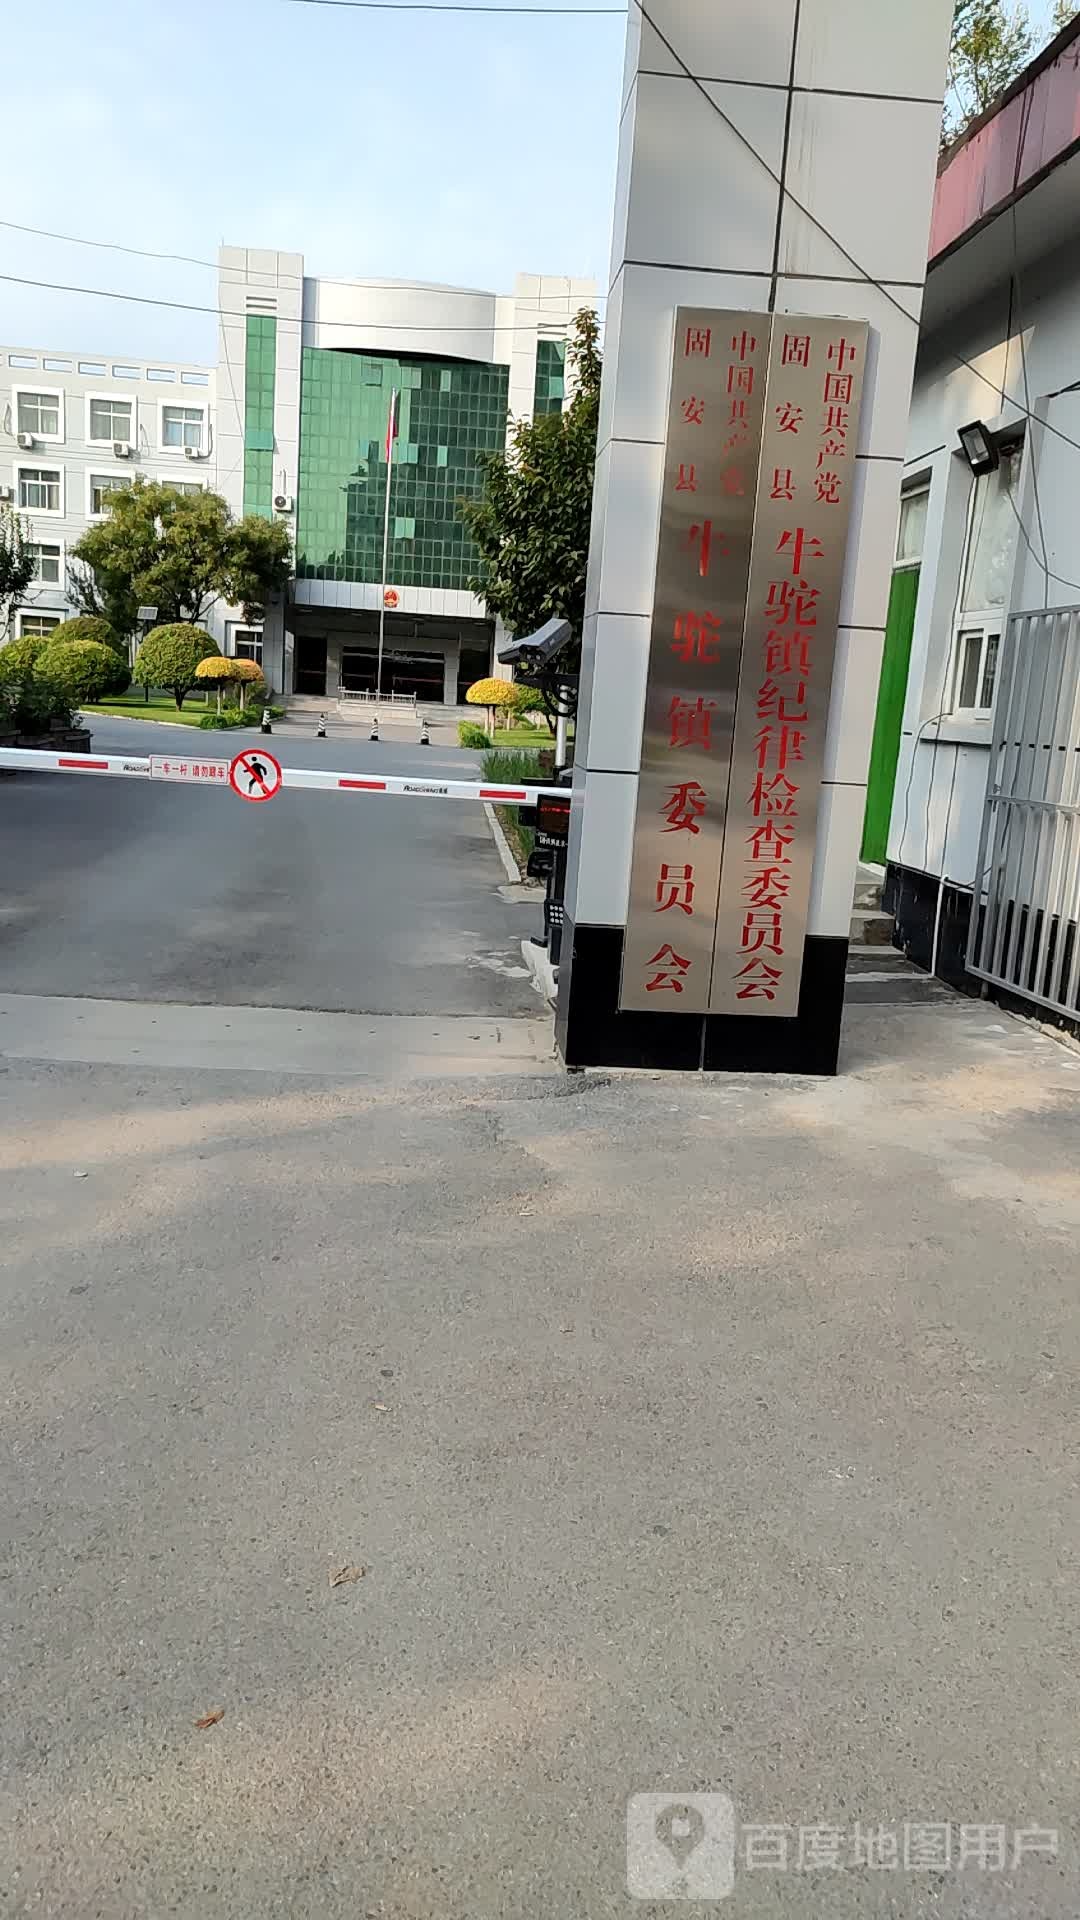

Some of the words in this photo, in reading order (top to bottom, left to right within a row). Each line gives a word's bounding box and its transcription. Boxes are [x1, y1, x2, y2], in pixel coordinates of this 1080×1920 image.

[675, 327, 712, 492] 固安县
[769, 333, 812, 501] 固安县
[814, 338, 857, 504] 中国共产党
[731, 527, 826, 1001] 牛驼镇纪律检查委员会
